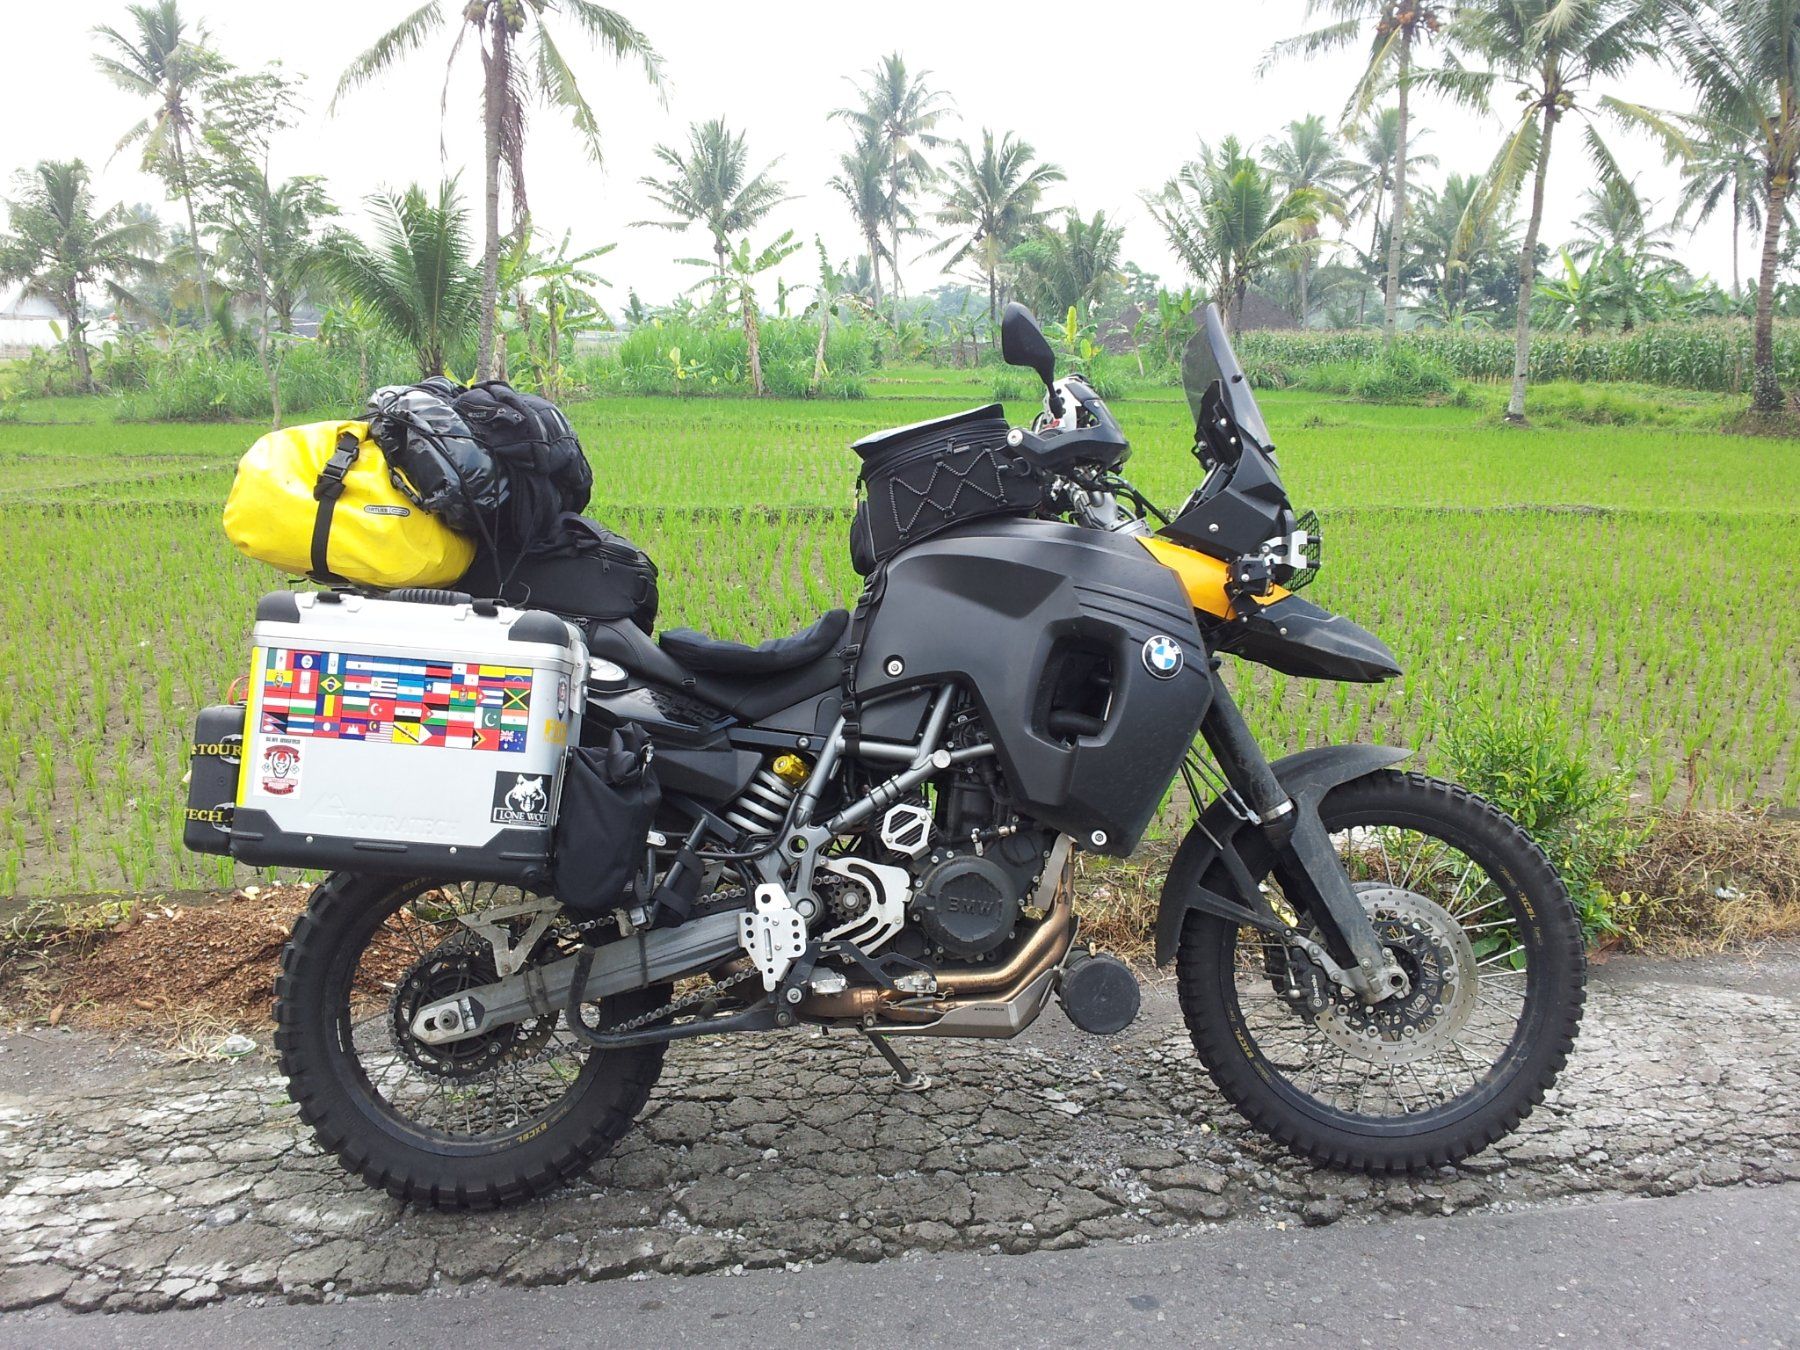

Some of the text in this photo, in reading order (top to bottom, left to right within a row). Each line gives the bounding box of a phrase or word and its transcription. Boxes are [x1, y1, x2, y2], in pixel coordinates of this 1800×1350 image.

[1148, 637, 1182, 655] BMW
[499, 810, 526, 820] LONE
[948, 896, 995, 915] BMW
[516, 1122, 548, 1142] EXCEL
